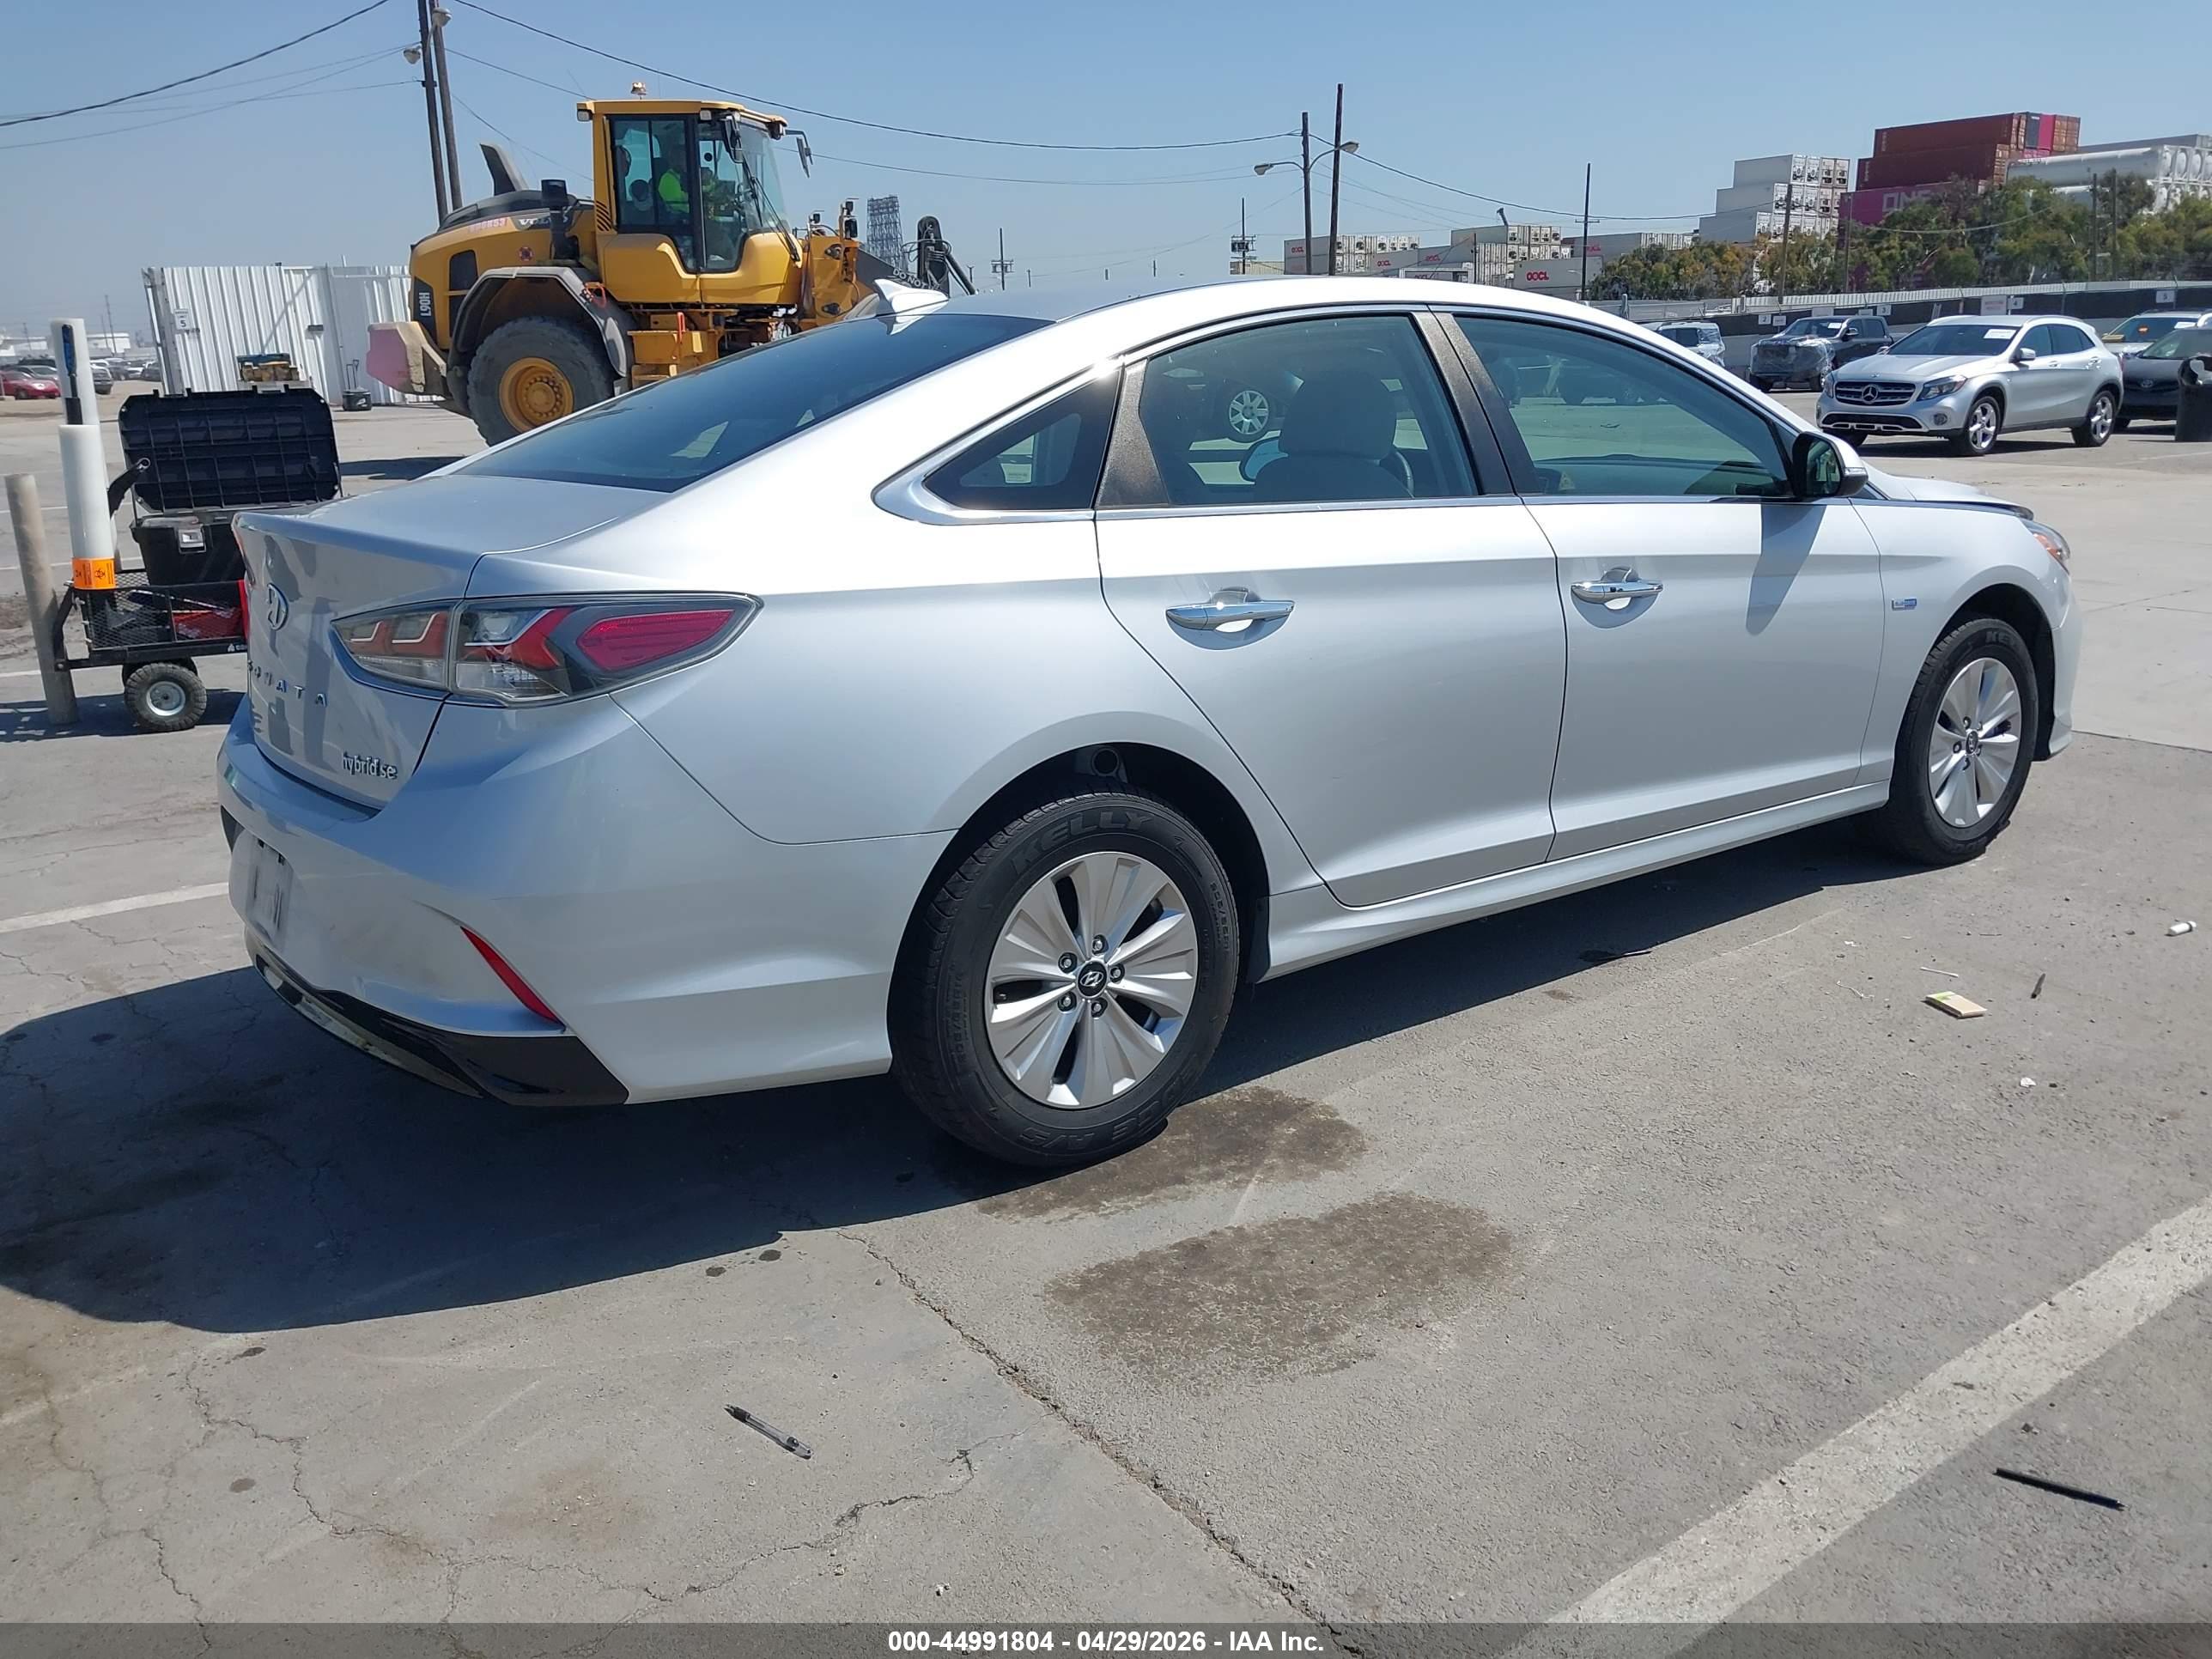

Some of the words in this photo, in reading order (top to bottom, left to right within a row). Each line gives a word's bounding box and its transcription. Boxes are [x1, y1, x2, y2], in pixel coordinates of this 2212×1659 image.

[893, 268, 907, 280] DO
[1527, 271, 1549, 282] OOCL
[418, 292, 432, 317] L90H
[247, 659, 328, 708] SONATA
[343, 750, 380, 776] hybrid
[380, 763, 398, 779] se
[1011, 811, 1153, 876] KELLY
